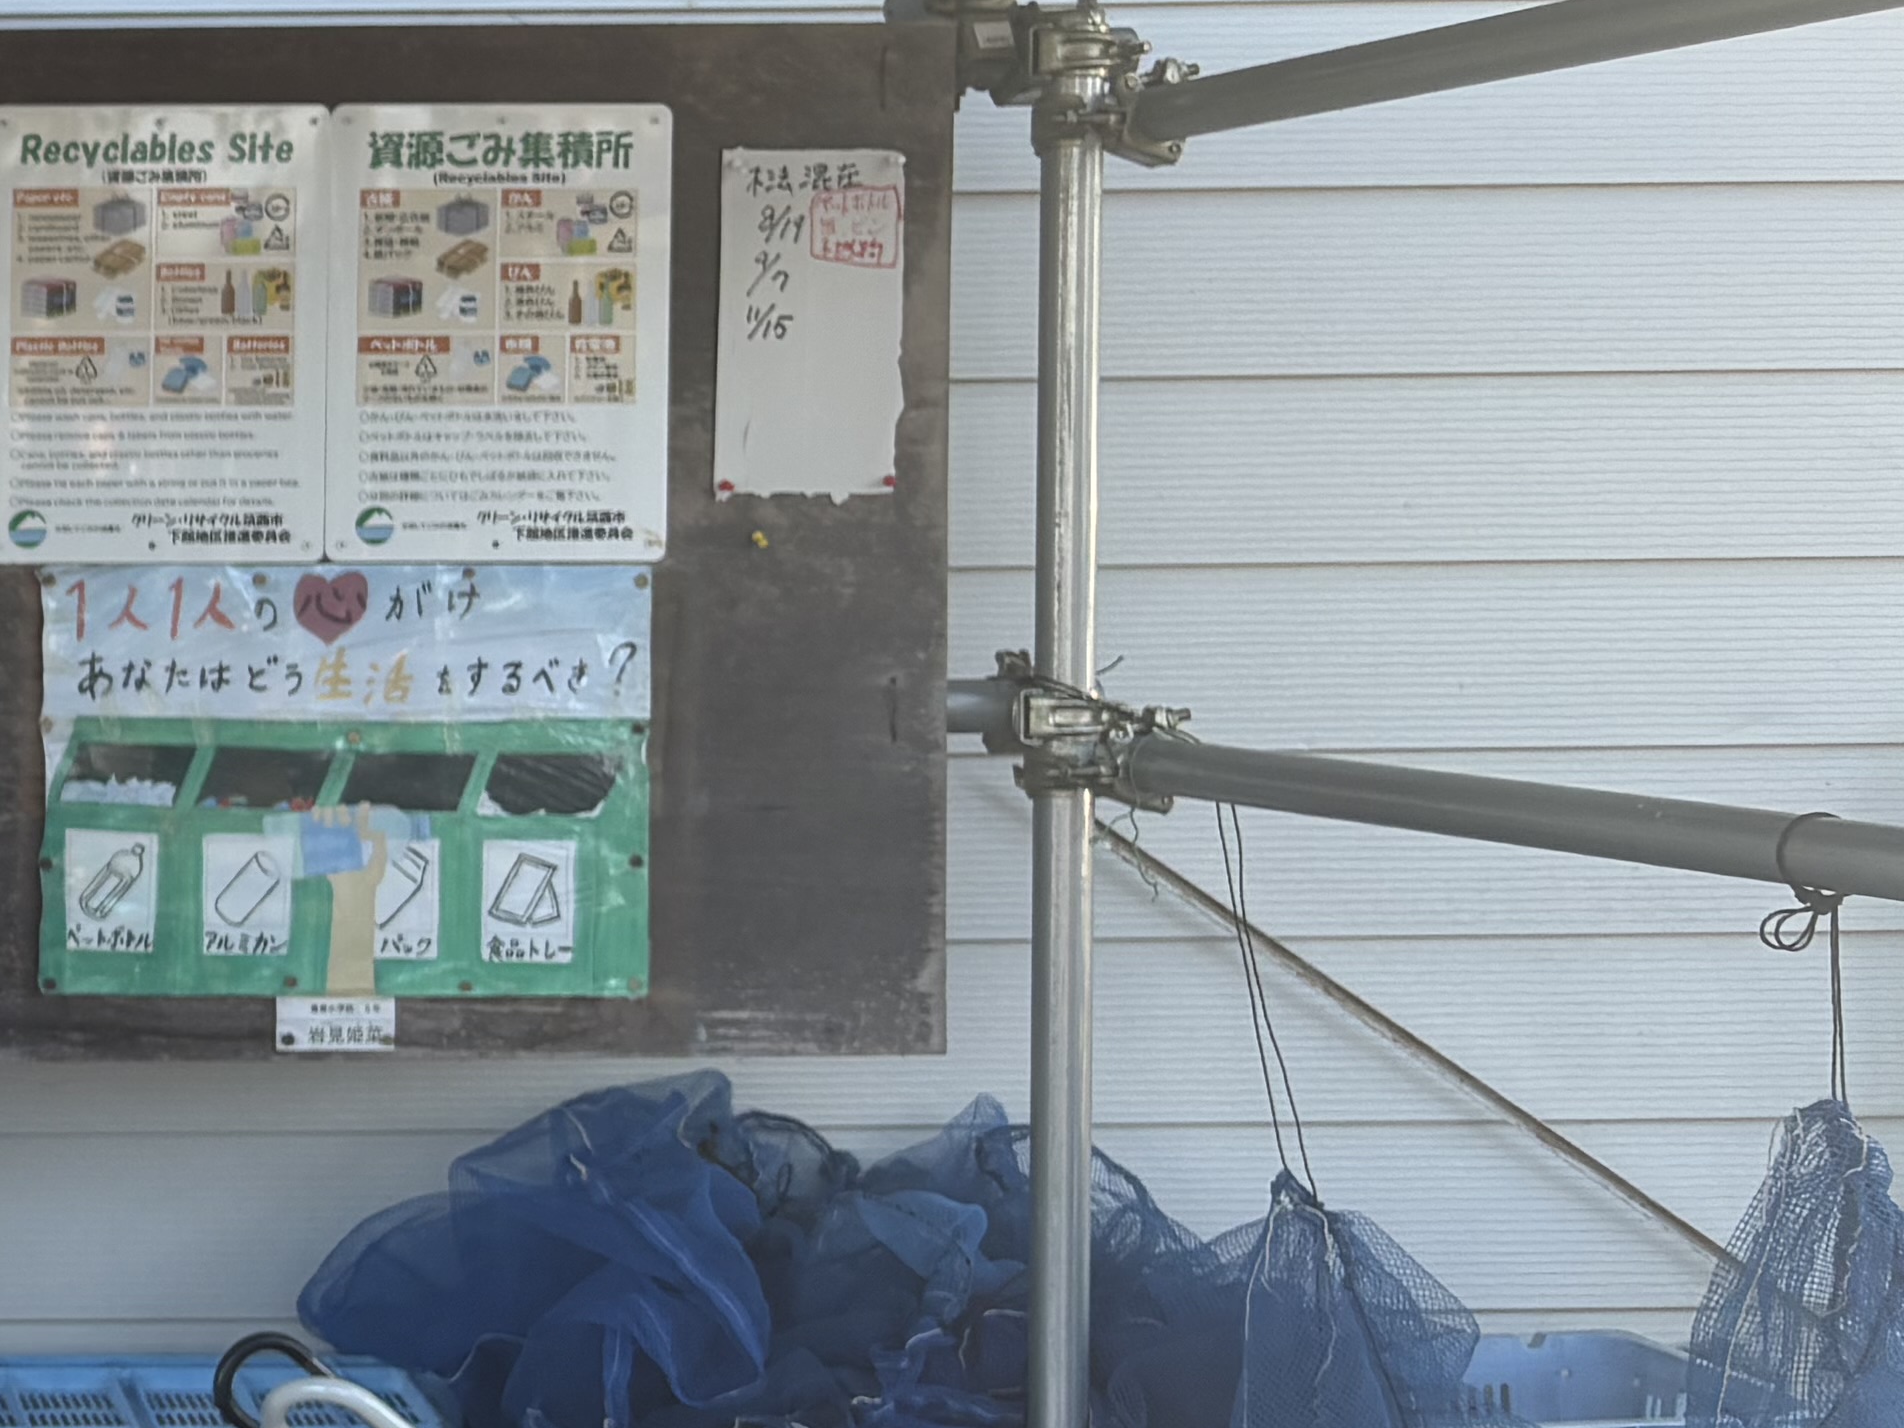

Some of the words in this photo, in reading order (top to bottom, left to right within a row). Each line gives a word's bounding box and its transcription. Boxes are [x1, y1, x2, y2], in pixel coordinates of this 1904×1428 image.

[20, 134, 215, 168] Recyclables
[228, 132, 294, 164] Site
[368, 131, 634, 169] 資源ごみ集積所
[204, 929, 287, 955] アルミカン
[379, 936, 433, 957] パック
[487, 936, 573, 961] 食品トレー
